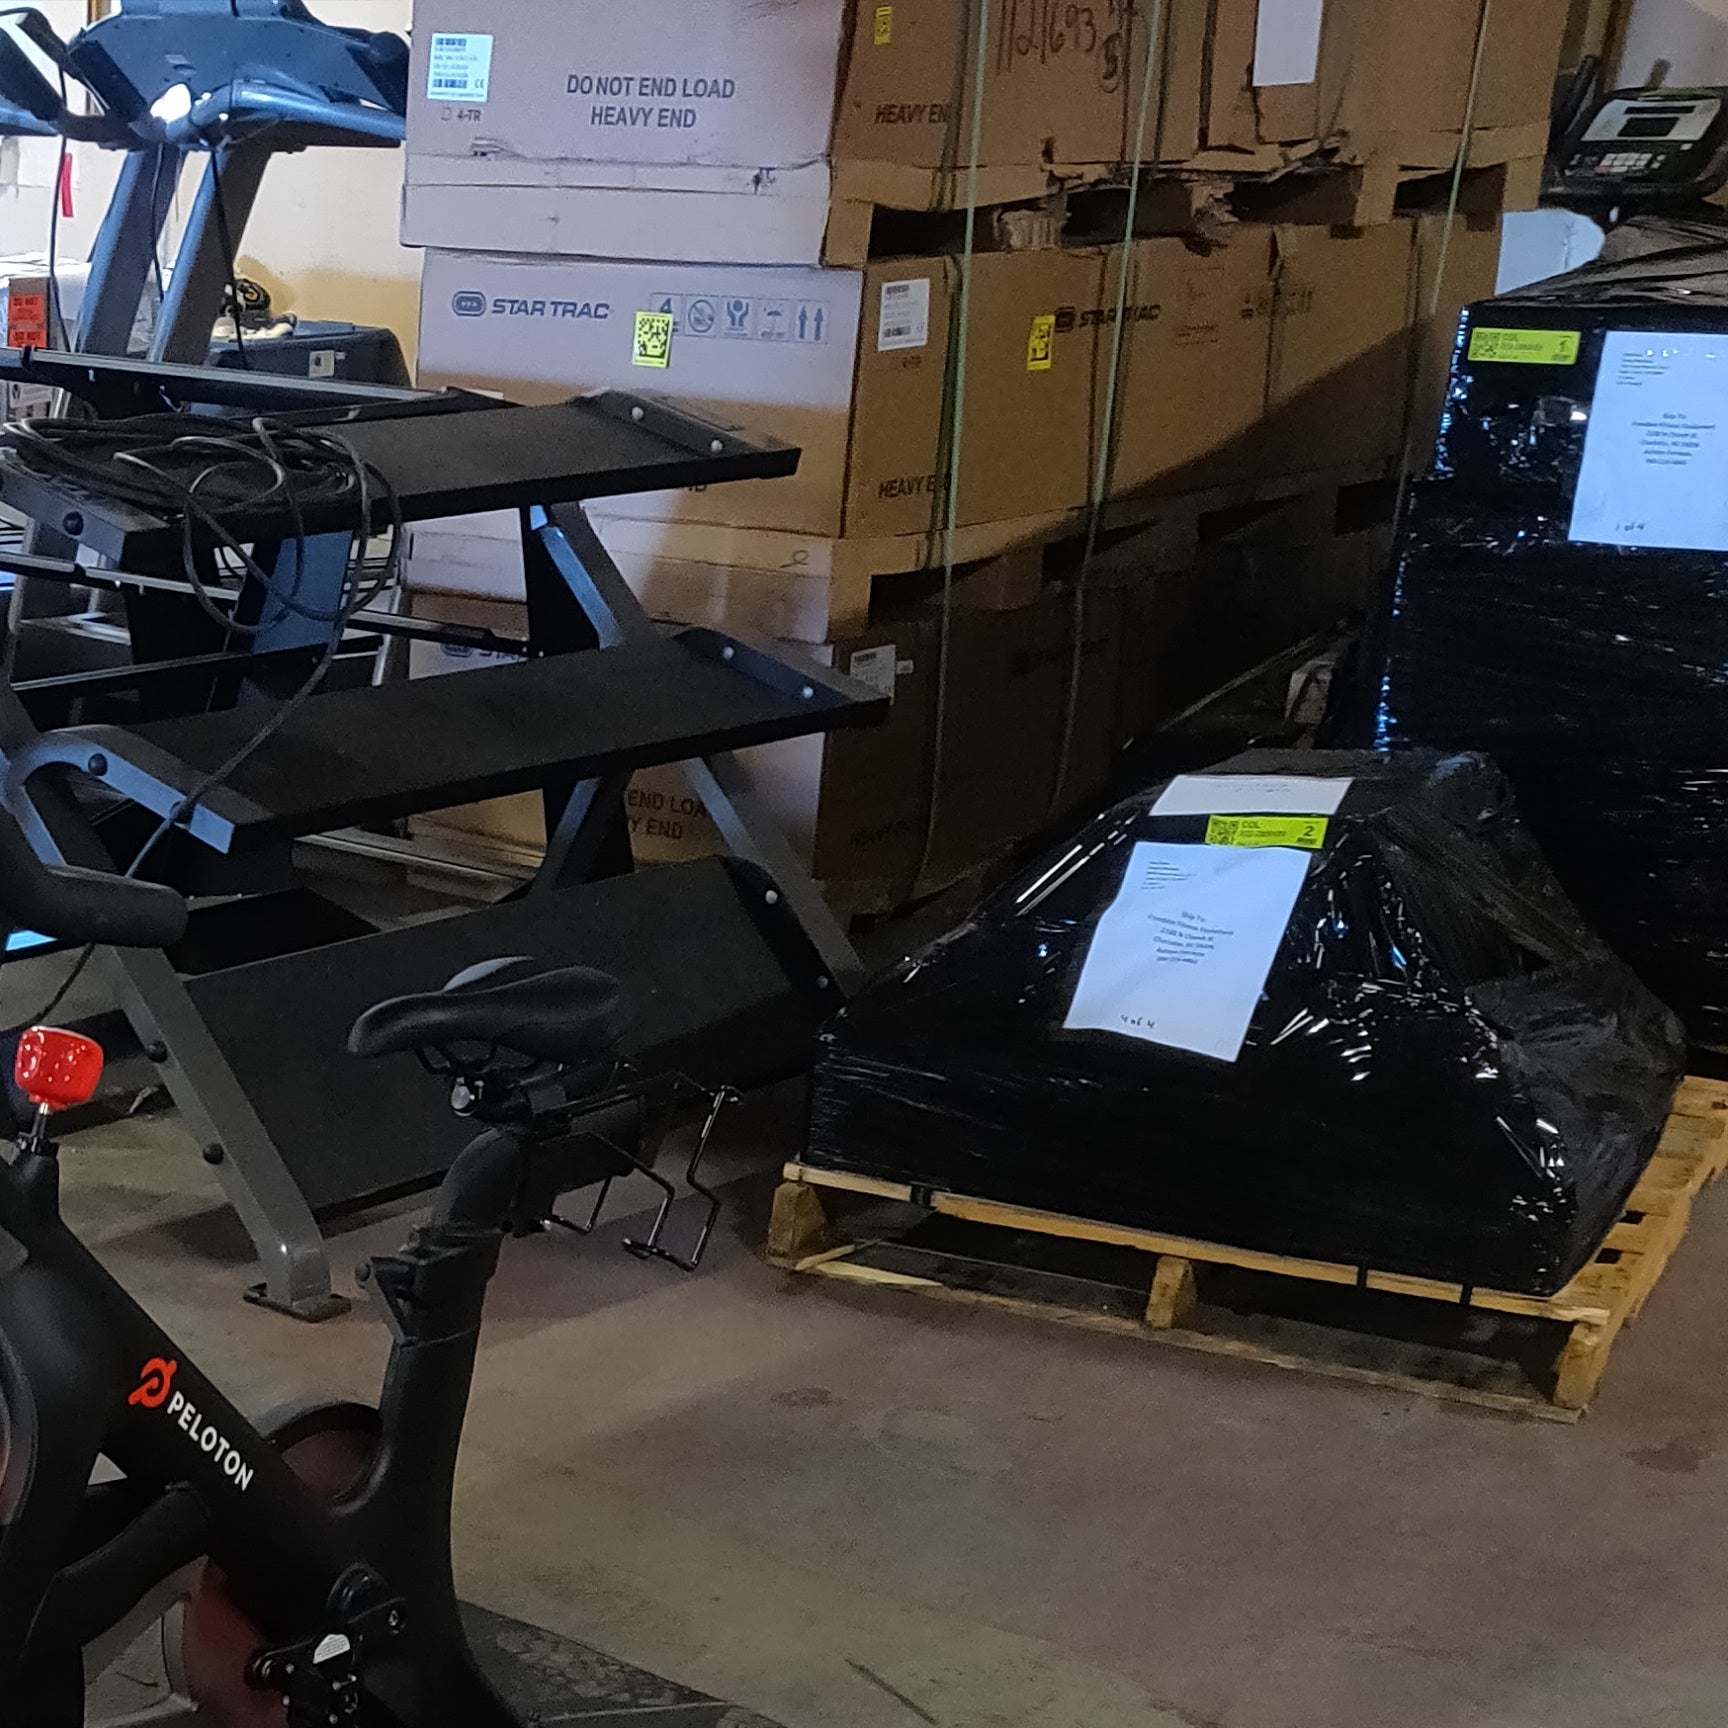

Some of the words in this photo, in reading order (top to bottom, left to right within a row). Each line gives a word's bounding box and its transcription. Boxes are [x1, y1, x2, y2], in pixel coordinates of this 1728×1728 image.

[567, 74, 593, 95] DO
[596, 76, 634, 97] NOT
[638, 77, 677, 98] END
[682, 78, 736, 99] LOAD
[590, 105, 653, 128] HEAVY
[657, 108, 697, 129] END
[874, 103, 927, 124] HEAVY
[491, 298, 546, 317] STAR
[550, 301, 611, 320] TRAC
[878, 475, 927, 499] HEAVY
[628, 790, 664, 811] END
[670, 796, 708, 818] LOA
[646, 820, 682, 840] END
[1303, 825, 1316, 837] 2
[166, 1390, 254, 1492] PELOTON
